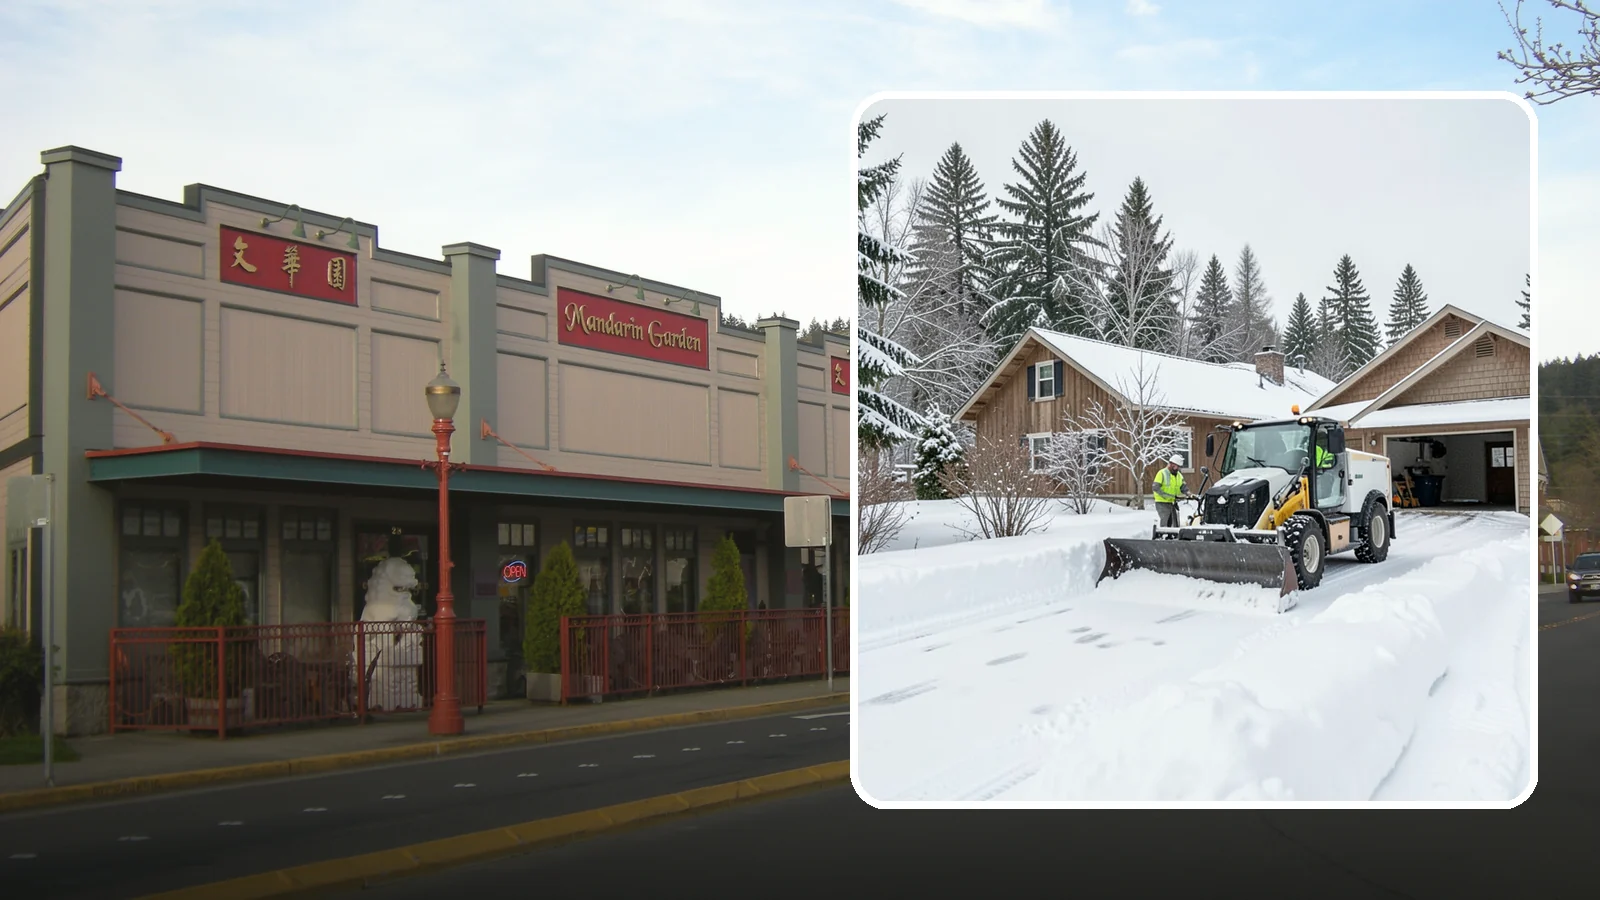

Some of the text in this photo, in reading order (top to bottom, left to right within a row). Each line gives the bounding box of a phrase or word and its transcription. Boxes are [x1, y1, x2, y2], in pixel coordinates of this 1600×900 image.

[230, 235, 346, 291] 文華園
[564, 302, 702, 352] Mandarin Garden
[503, 565, 527, 578] OPEN
